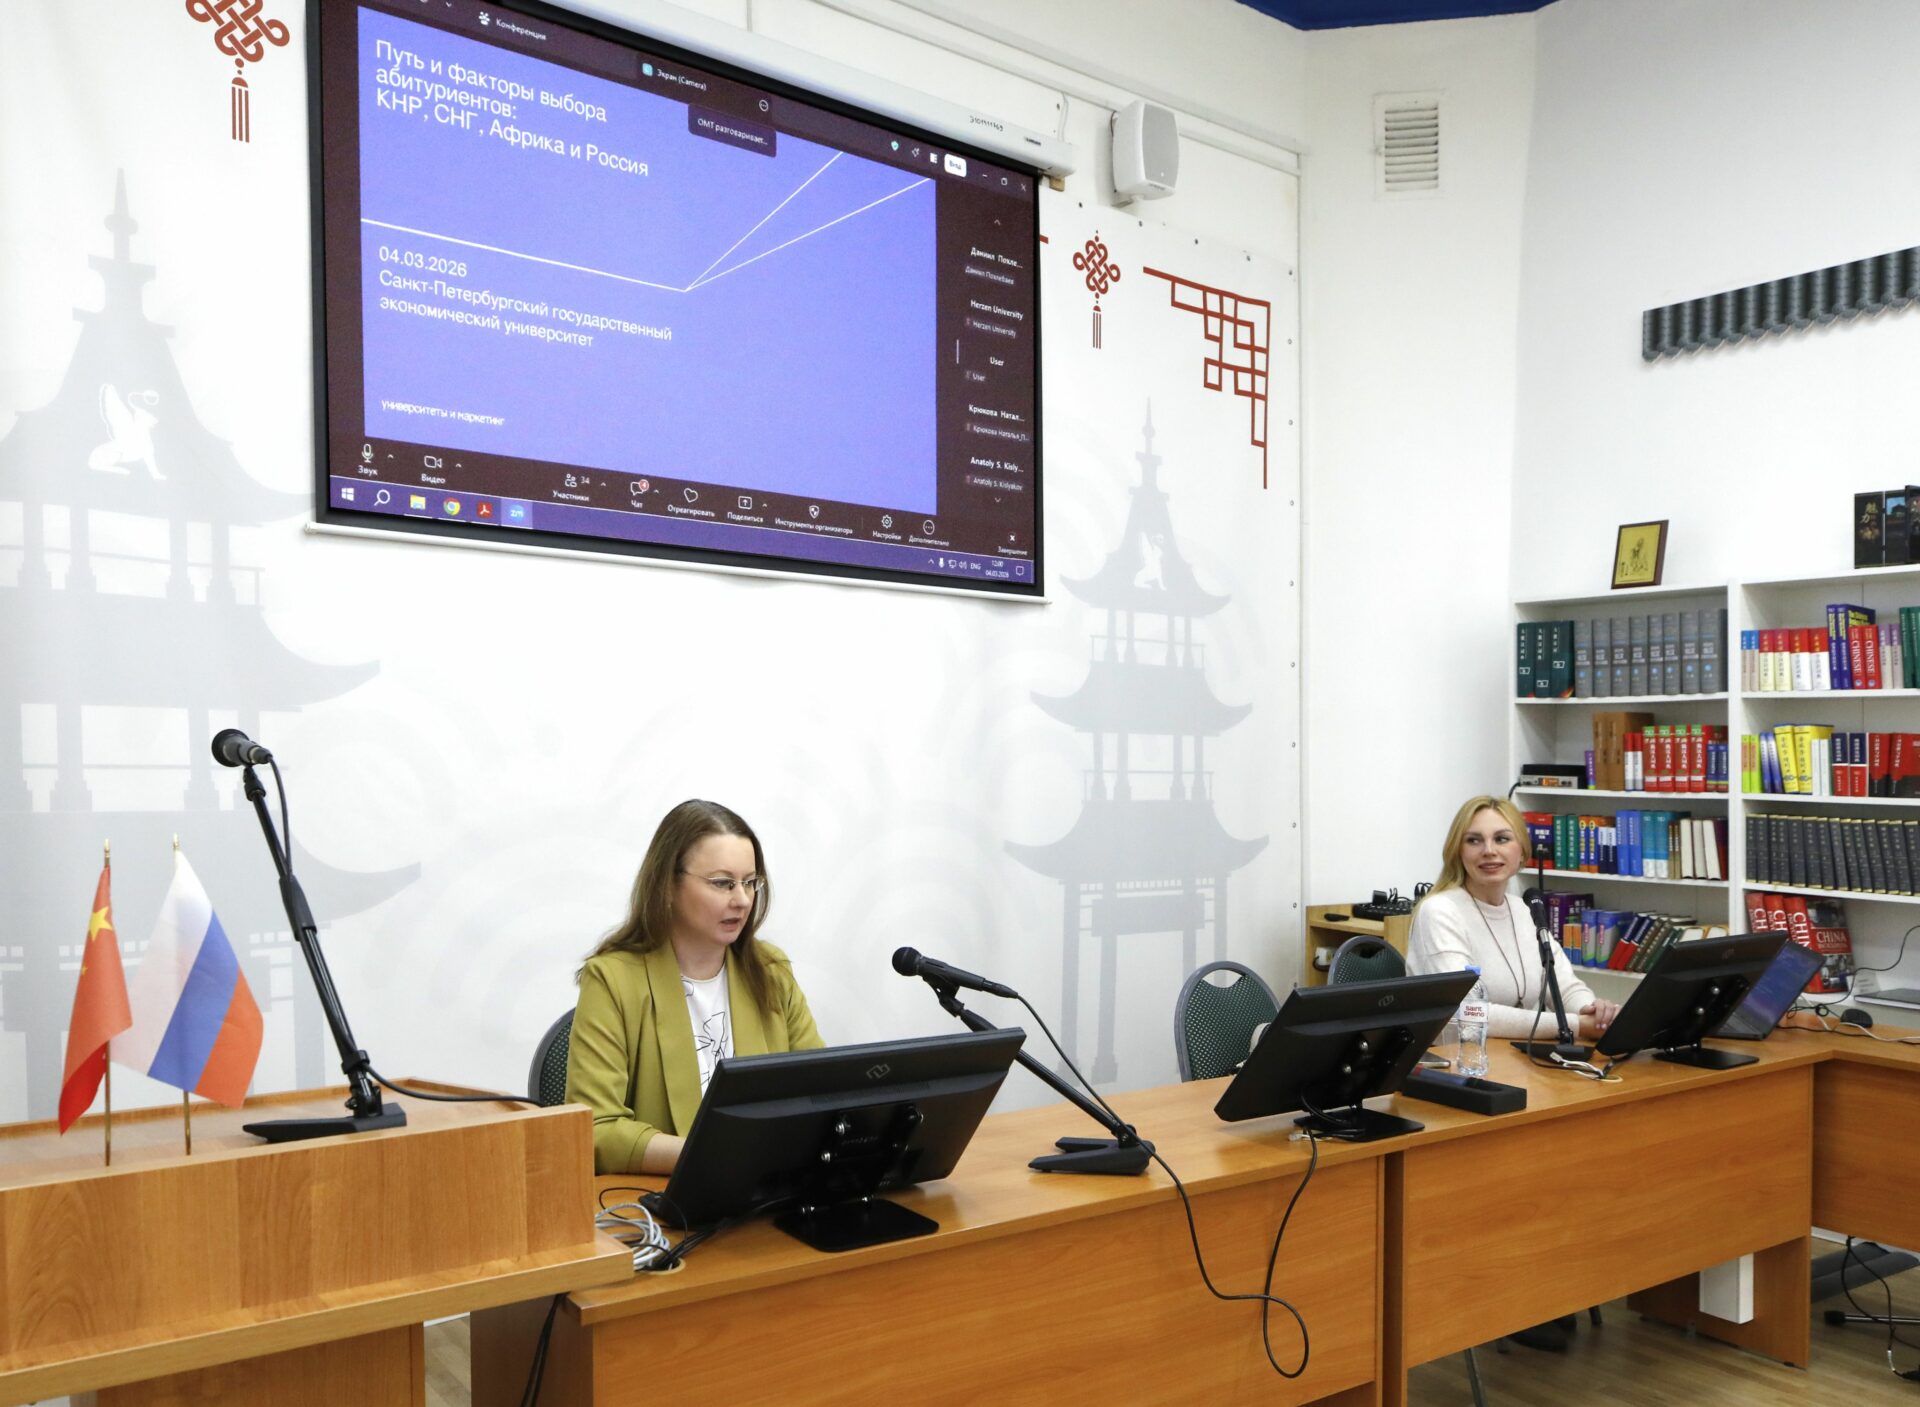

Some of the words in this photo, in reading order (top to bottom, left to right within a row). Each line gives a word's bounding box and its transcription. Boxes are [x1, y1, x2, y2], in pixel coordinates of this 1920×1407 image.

[496, 18, 547, 41] Конференция
[376, 39, 425, 70] Путь
[430, 57, 442, 75] и
[448, 58, 534, 102] факторы
[540, 87, 607, 122] выбора
[657, 69, 677, 82] Экран
[376, 67, 517, 119] абитуриентов:
[376, 88, 429, 121] КНР,
[434, 103, 484, 136] СНГ,
[490, 120, 565, 156] Африка
[570, 143, 581, 158] и
[587, 144, 648, 177] Россия
[379, 246, 468, 277] 04.03.2026
[379, 269, 548, 317] Санкт-Петербургский
[552, 307, 672, 341] государственный
[971, 299, 992, 312] Herzen
[993, 306, 1024, 321] University
[380, 297, 500, 330] экономический
[504, 318, 593, 346] университет
[990, 356, 1004, 366] User
[972, 373, 985, 381] User
[381, 399, 448, 418] университеты
[450, 411, 456, 419] и
[968, 404, 998, 417] Крюкова
[971, 457, 994, 469] Anatoly
[358, 465, 378, 477] Звук
[421, 474, 446, 484] Видео
[581, 477, 590, 485] 34
[552, 490, 590, 502] Участники
[631, 501, 644, 509] Чат
[667, 504, 715, 517] Отреагировать
[727, 511, 764, 523] Поделиться
[775, 517, 814, 531] Инструменты
[815, 524, 853, 535] организатора
[873, 530, 902, 541] Настройки
[970, 562, 981, 571] ENG
[1816, 931, 1847, 943] CHINA
